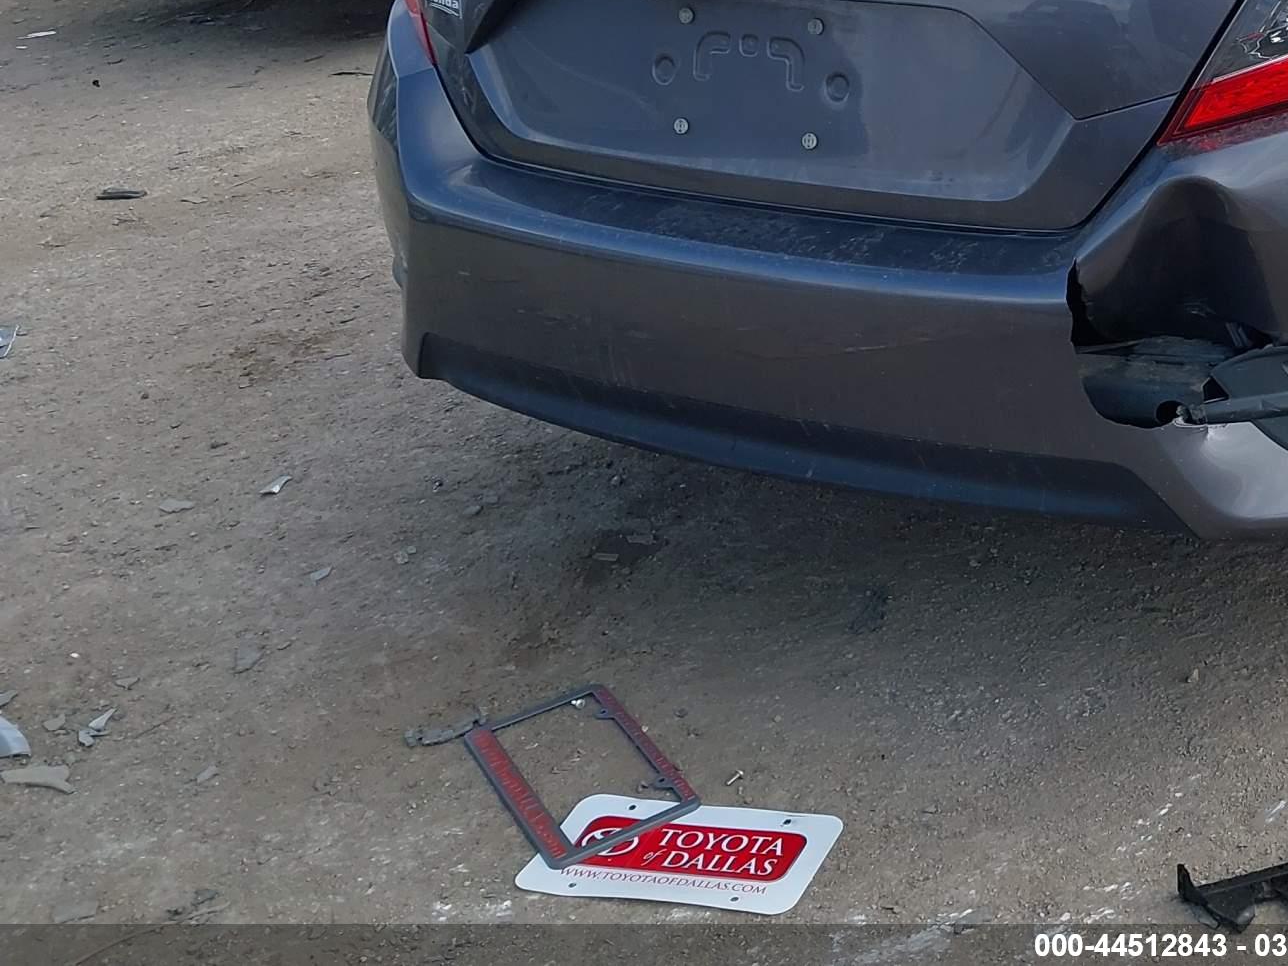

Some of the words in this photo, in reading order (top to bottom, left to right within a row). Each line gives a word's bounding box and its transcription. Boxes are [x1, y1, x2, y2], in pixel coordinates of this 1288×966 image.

[658, 828, 784, 856] TOYOTA
[641, 848, 667, 866] of
[661, 850, 778, 876] DALLAS
[560, 867, 767, 895] WWW.TOYOTAOFDALLAS.COM
